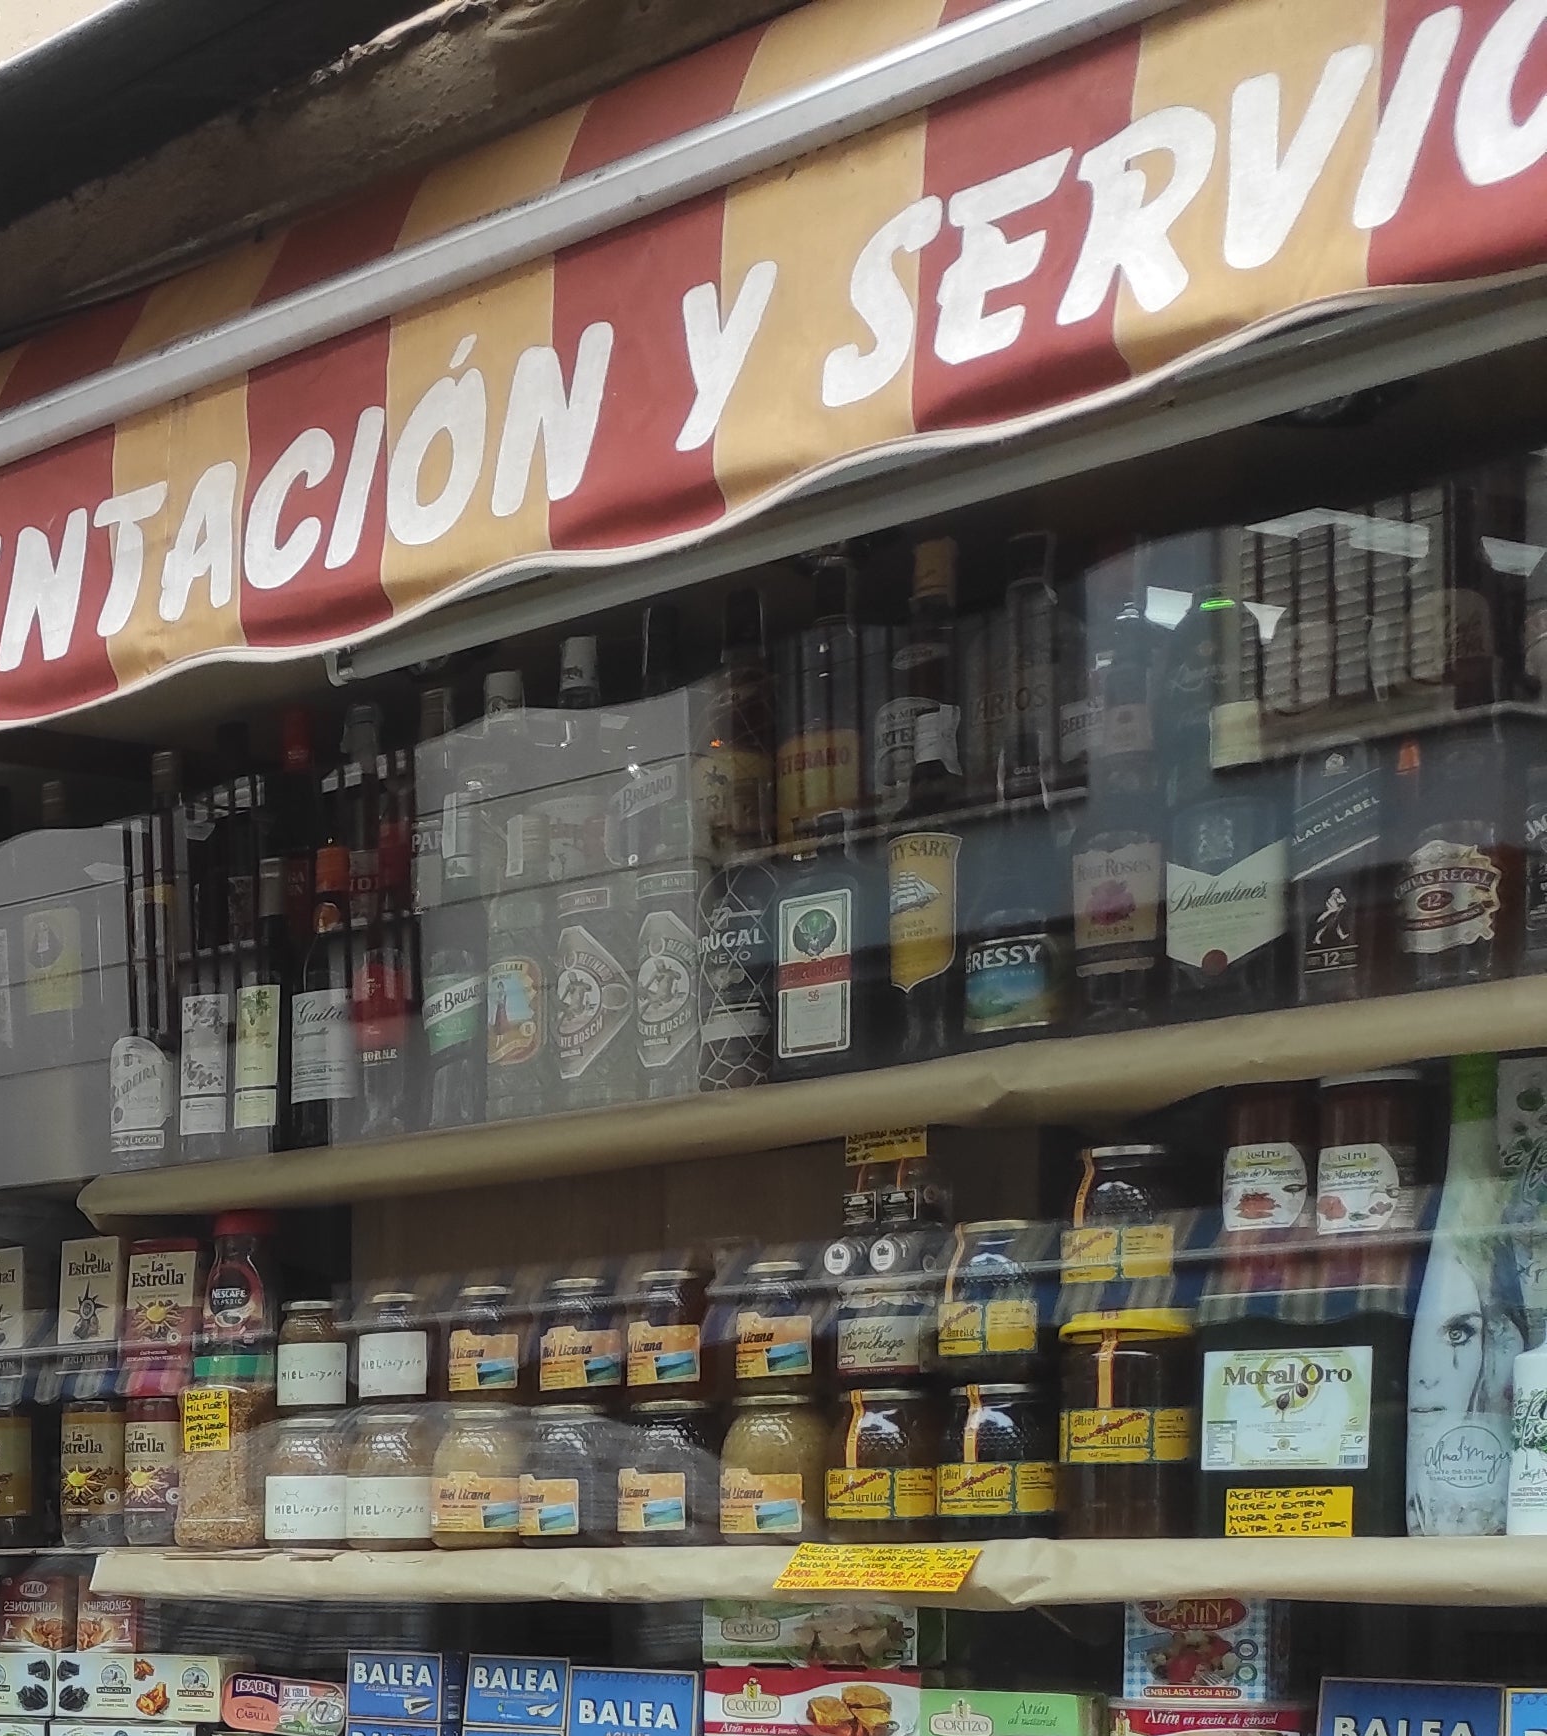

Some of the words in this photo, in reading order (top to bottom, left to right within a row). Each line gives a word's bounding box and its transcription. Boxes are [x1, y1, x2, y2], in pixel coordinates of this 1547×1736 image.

[675, 258, 779, 456] Y
[1333, 796, 1381, 829] LABEL
[1171, 879, 1269, 916] Ballantine's
[1321, 950, 1340, 968] 12
[85, 1251, 98, 1262] La
[68, 1260, 113, 1277] Estrella
[150, 1260, 165, 1273] La
[130, 1271, 186, 1289] Estrella
[1223, 1363, 1296, 1388] Moral
[1300, 1363, 1353, 1386] Oro
[71, 1430, 84, 1442] La
[133, 1430, 145, 1442] La
[1276, 1490, 1291, 1499] DE
[353, 1662, 433, 1688] BALEA
[473, 1666, 559, 1693] BALEA
[235, 1678, 279, 1698] ISABEL
[726, 1698, 777, 1713] CORTIZO
[1015, 1699, 1050, 1716] Atún
[578, 1699, 679, 1730] BALEA
[1145, 1709, 1180, 1726] Atún
[933, 1718, 989, 1733] CORTIZO
